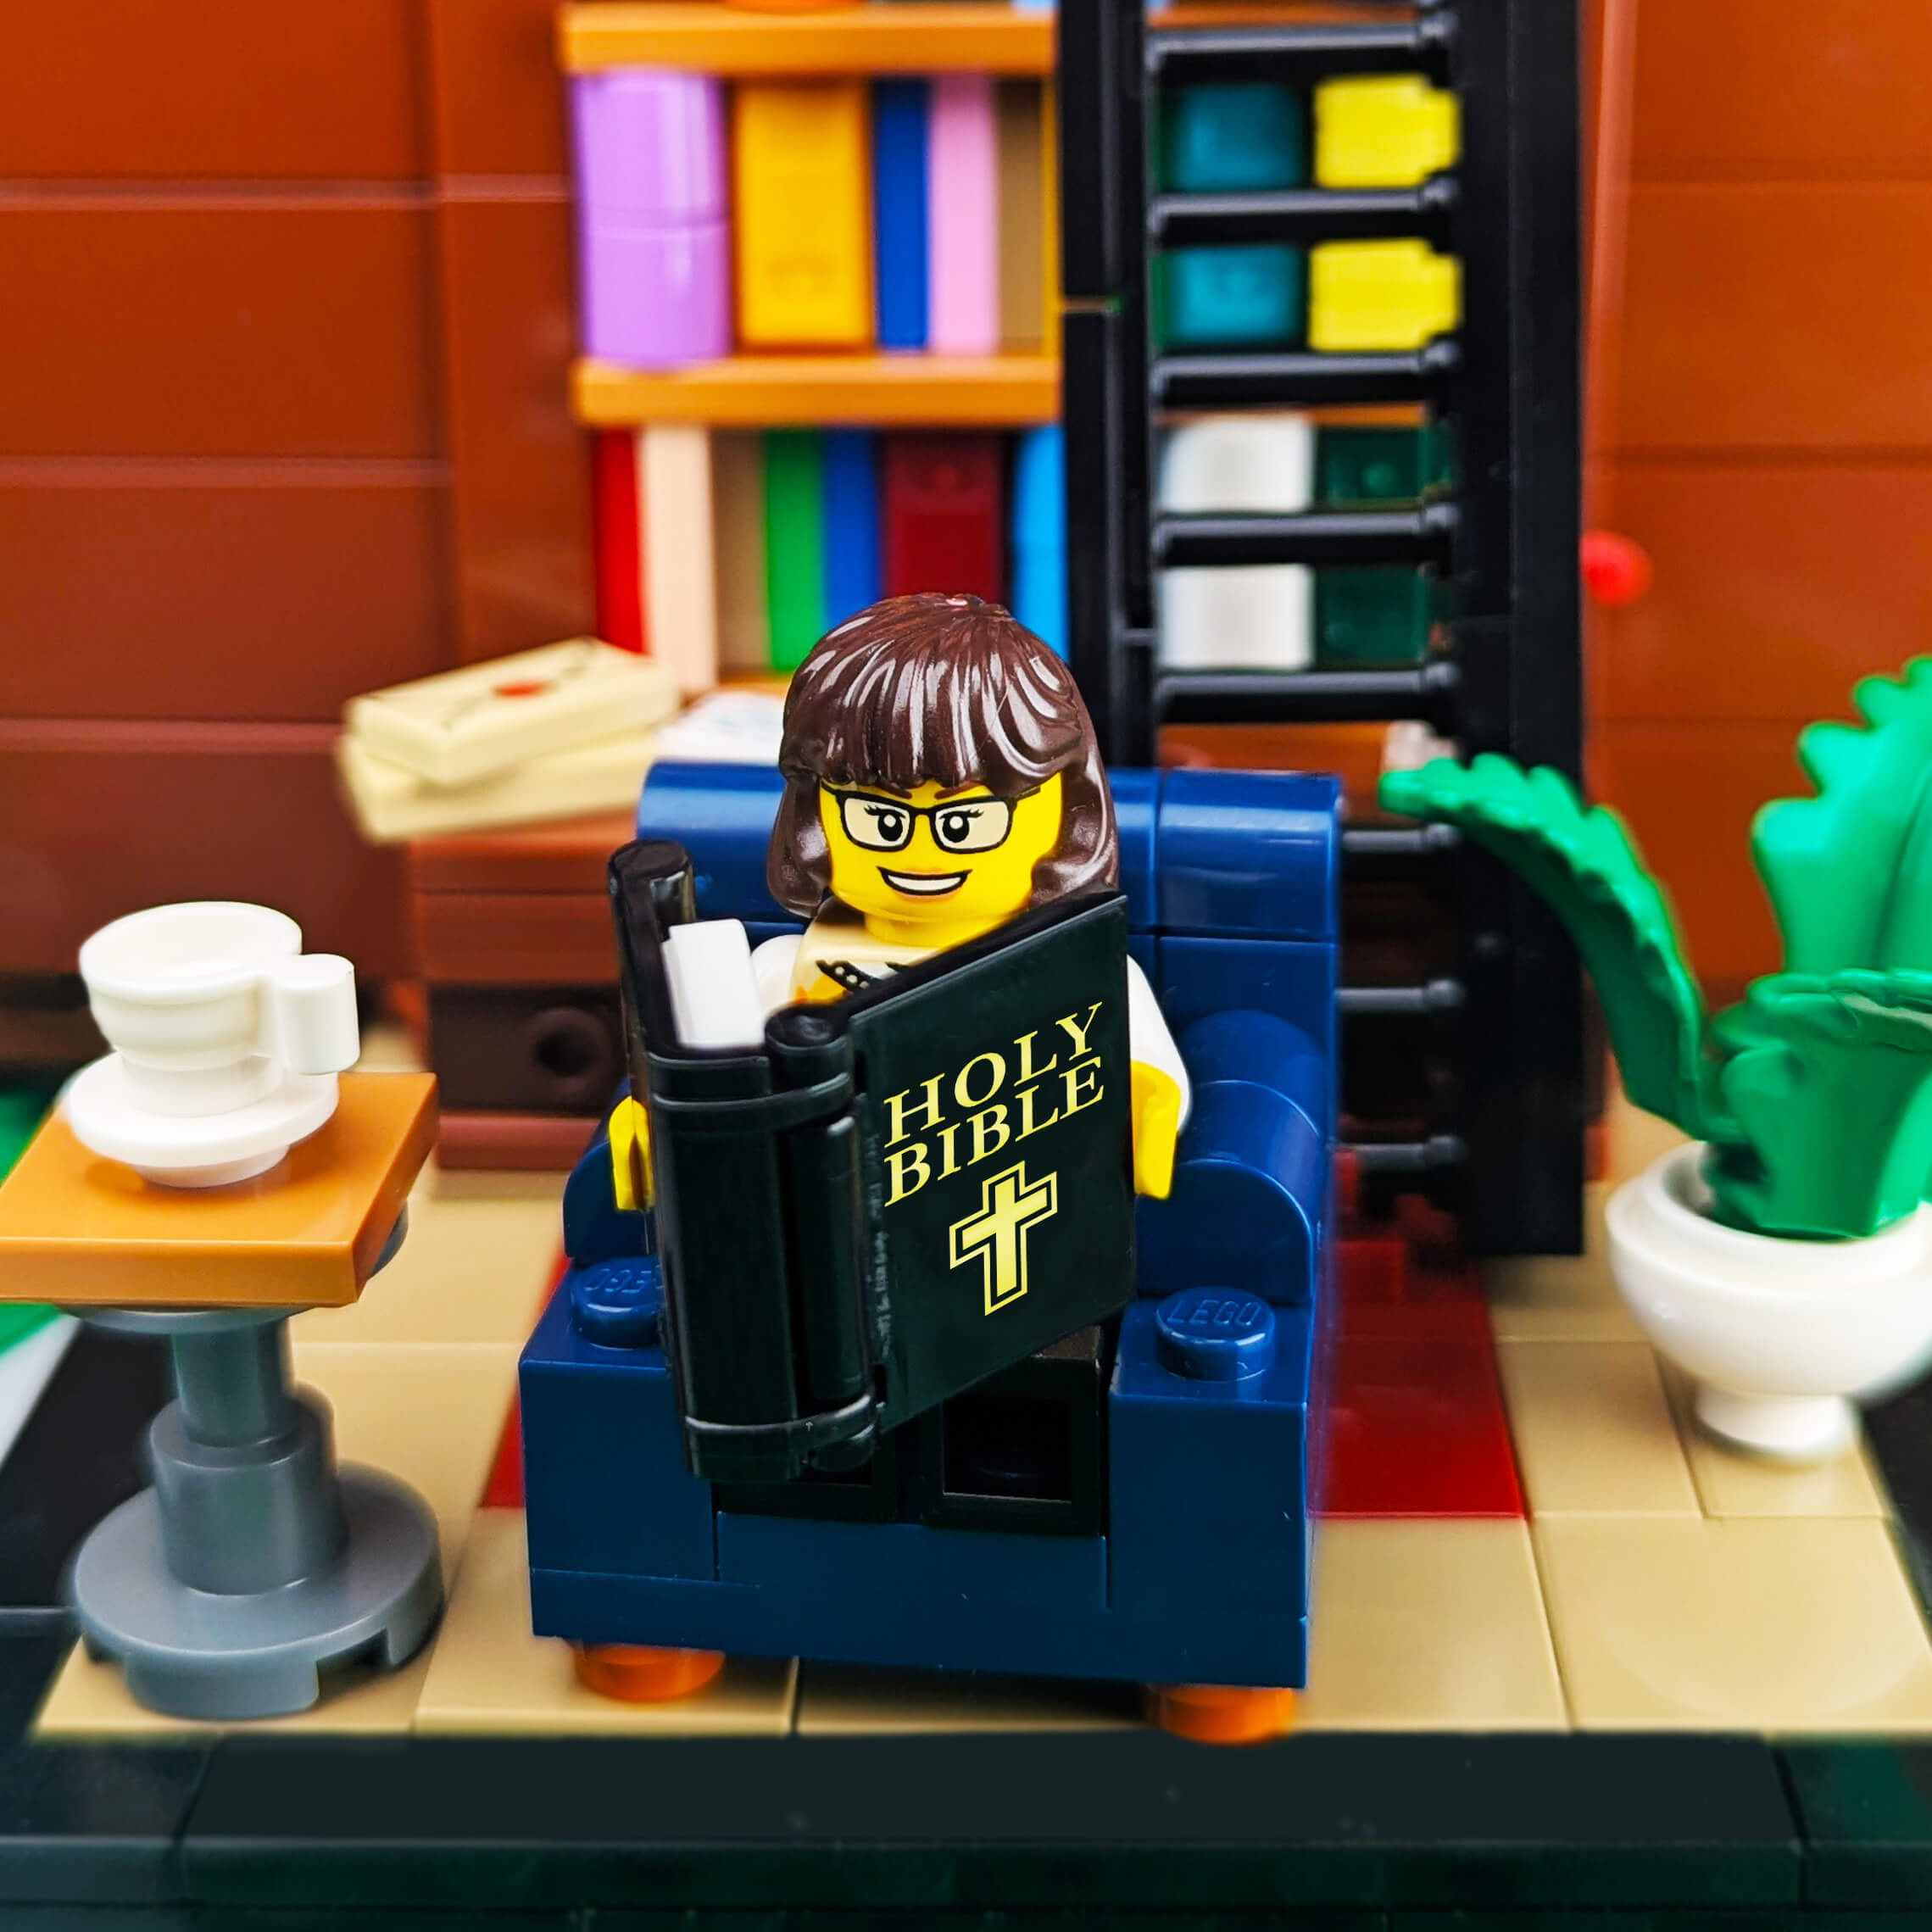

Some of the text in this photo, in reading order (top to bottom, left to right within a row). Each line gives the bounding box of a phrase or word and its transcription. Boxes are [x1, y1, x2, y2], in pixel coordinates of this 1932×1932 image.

[883, 1001, 1103, 1149] HOLY
[883, 1055, 1105, 1208] BIBLE
[1166, 1299, 1262, 1327] LEGO
